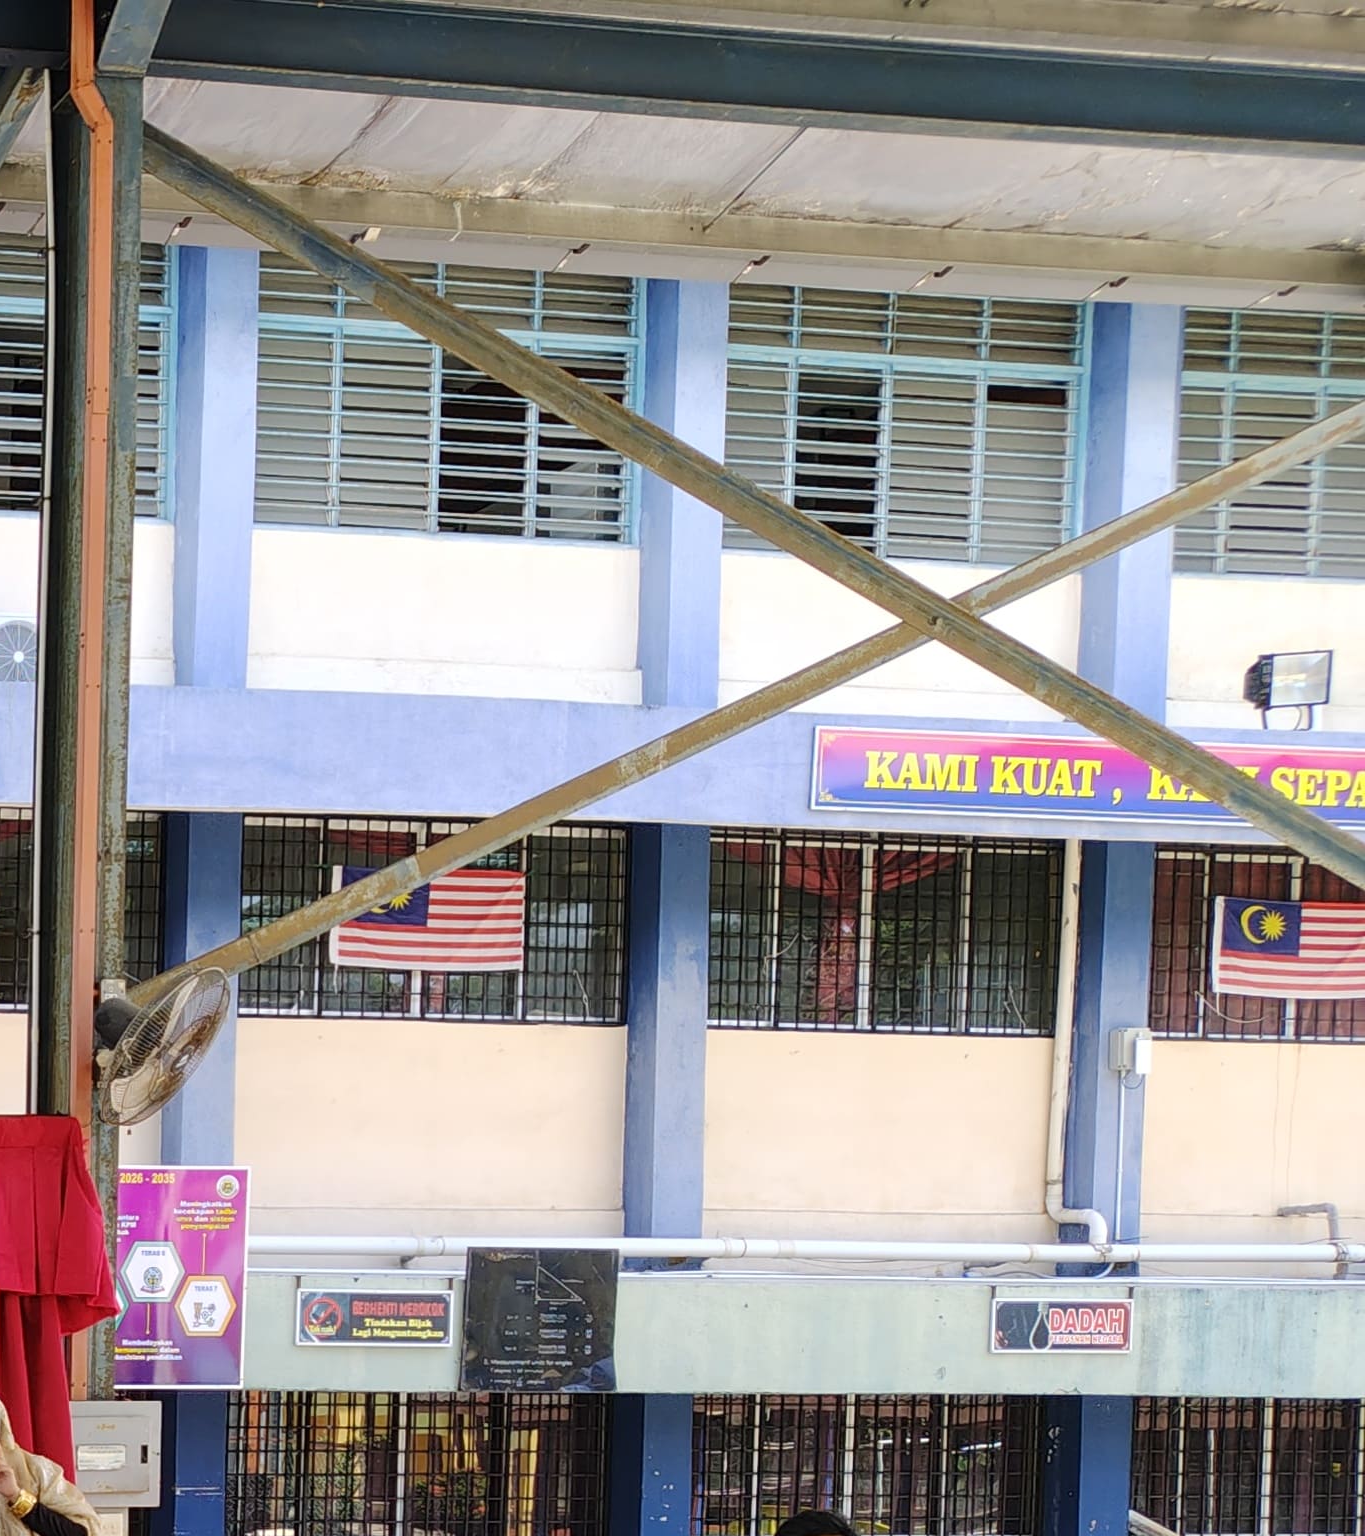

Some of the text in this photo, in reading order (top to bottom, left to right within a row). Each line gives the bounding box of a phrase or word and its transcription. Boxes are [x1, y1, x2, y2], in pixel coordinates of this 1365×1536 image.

[863, 750, 978, 794] KAMI
[989, 755, 1103, 799] KUAT
[119, 1173, 143, 1184] 2026
[151, 1173, 175, 1184] 2035
[352, 1300, 445, 1316] BERHENTI MEROKOK
[364, 1318, 433, 1328] Tindakan Bijak
[1049, 1308, 1124, 1333] DADAH
[352, 1328, 445, 1338] Lagi Menguntungkan
